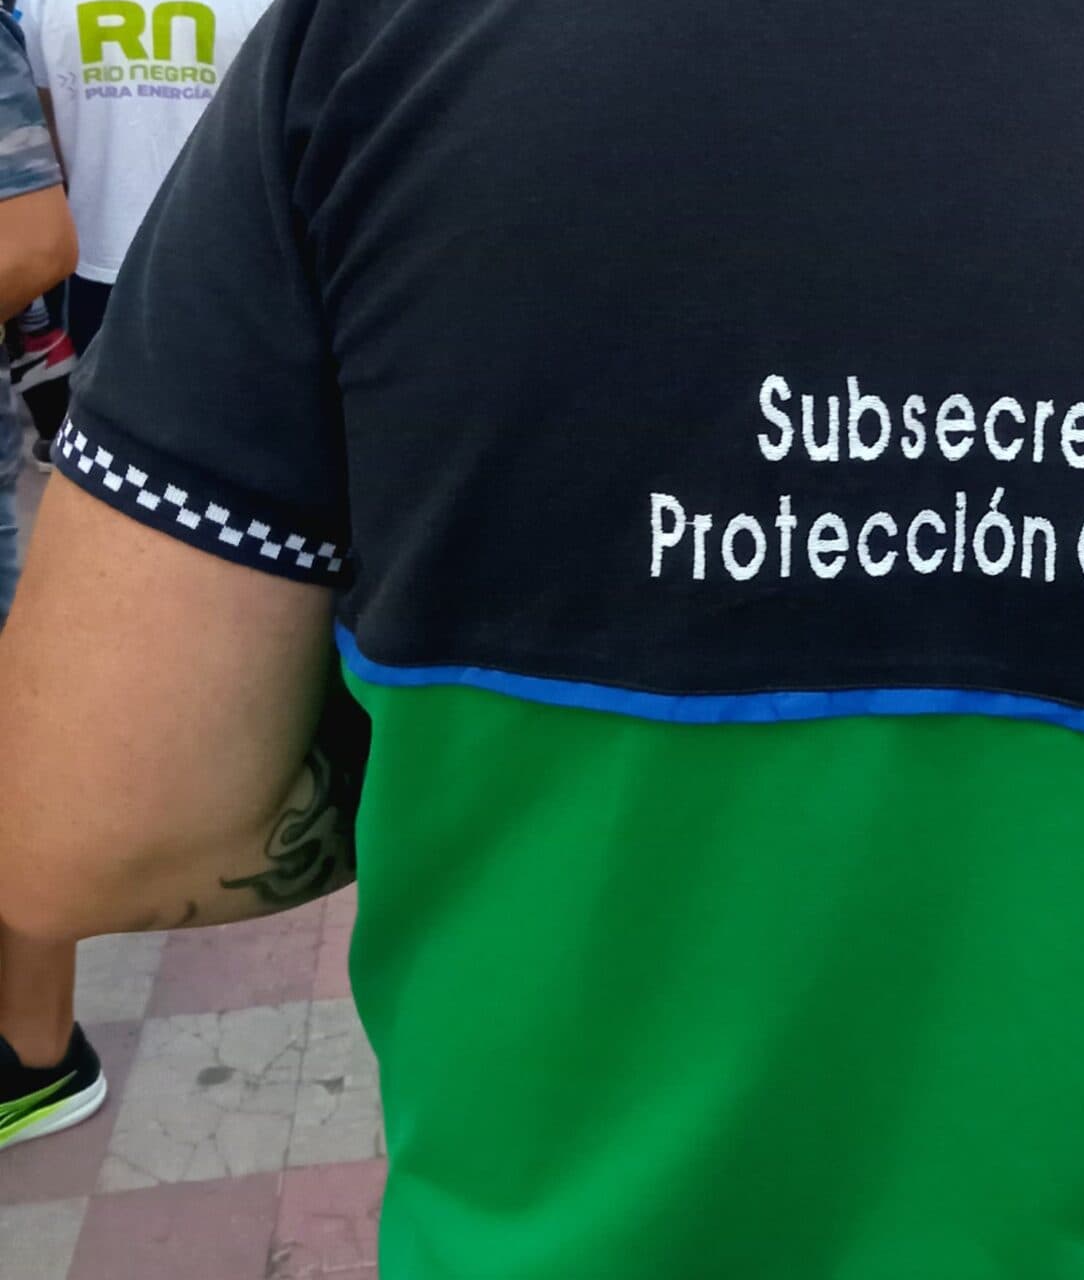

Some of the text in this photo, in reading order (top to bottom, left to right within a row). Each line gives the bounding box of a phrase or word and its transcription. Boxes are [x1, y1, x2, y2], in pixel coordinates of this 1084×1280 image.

[129, 64, 216, 84] NEGRO
[84, 84, 214, 101] PURA ENERGÍA
[650, 487, 1057, 581] Protección
